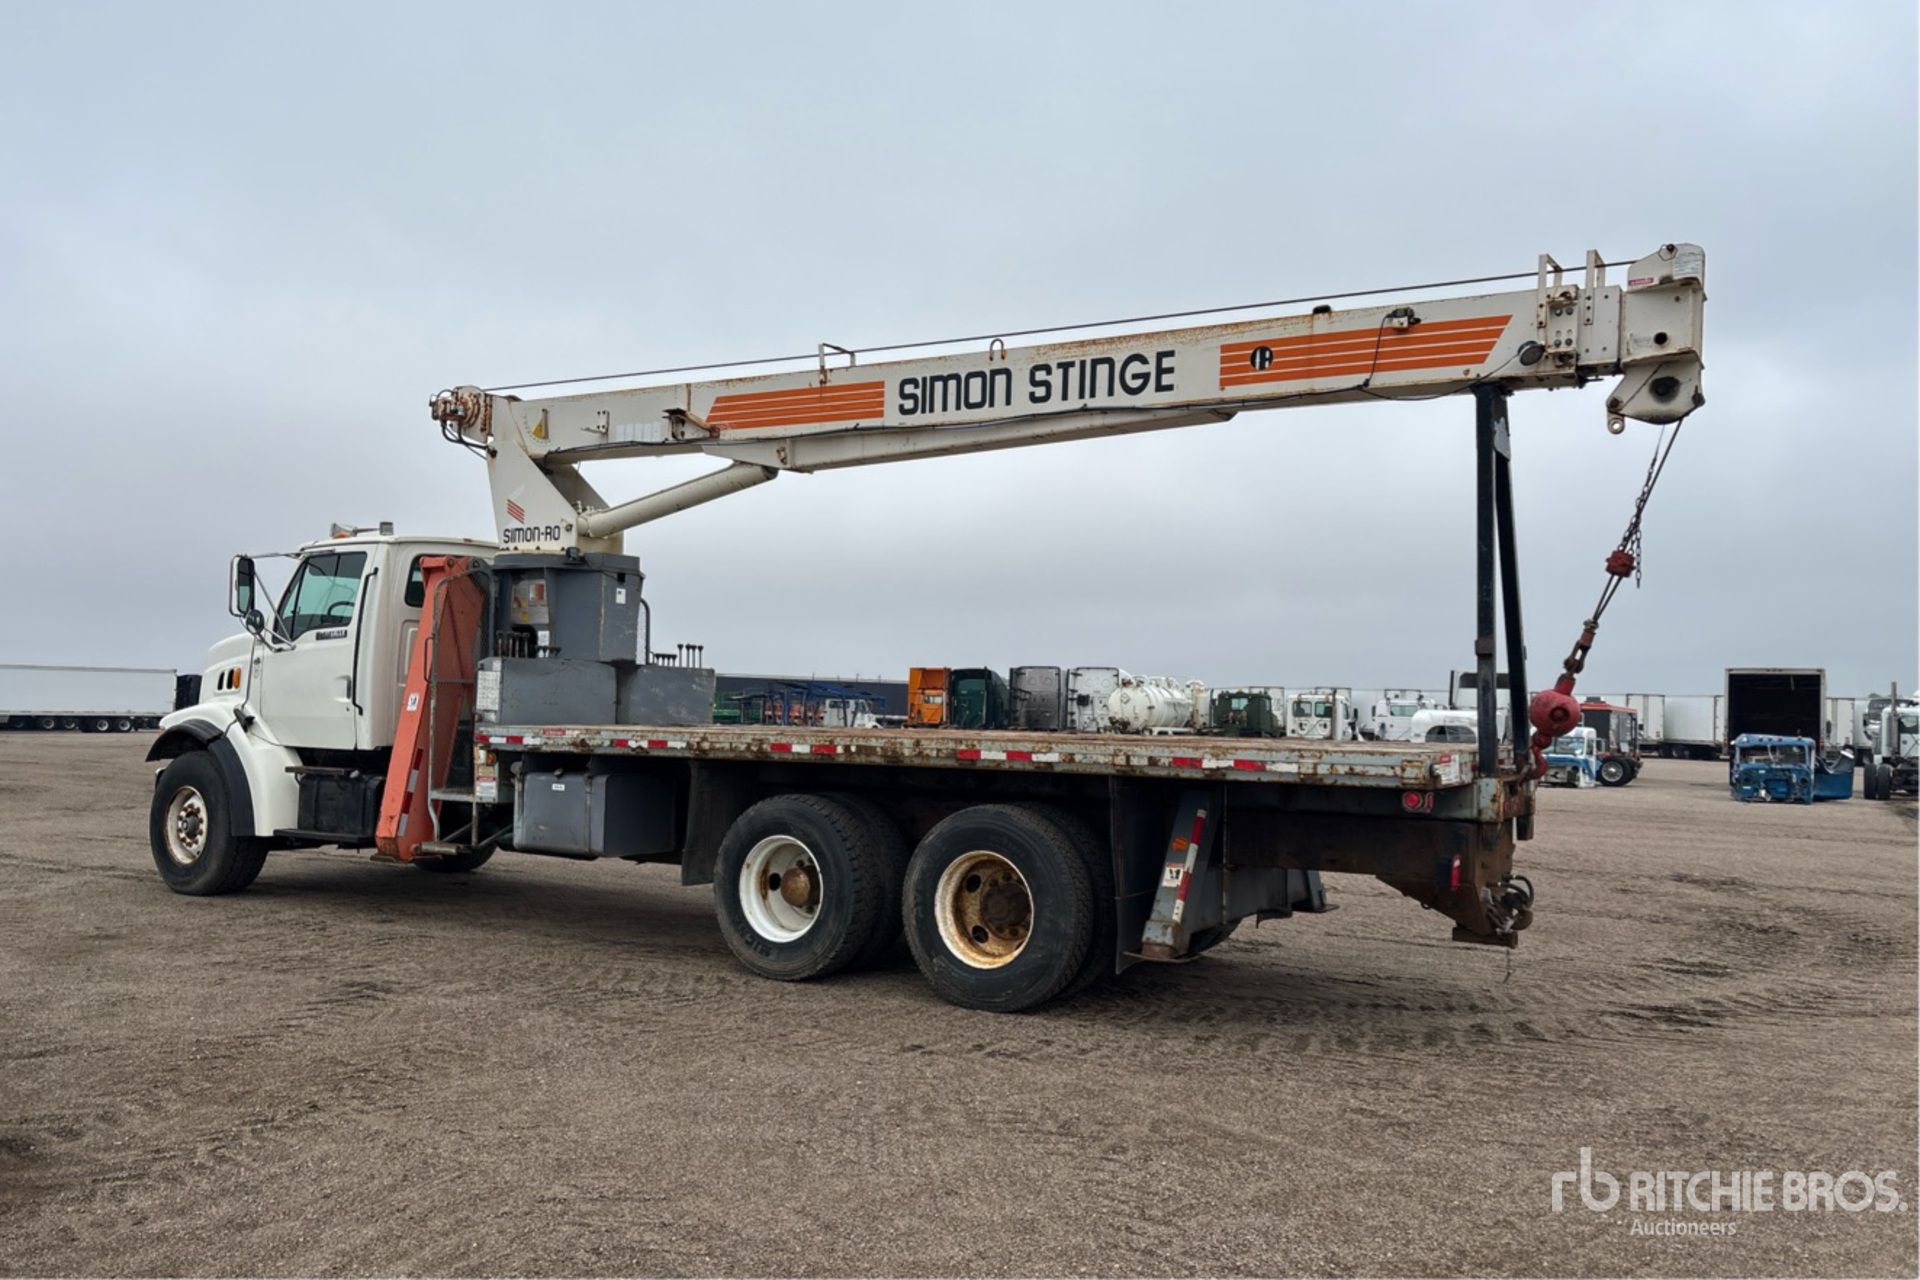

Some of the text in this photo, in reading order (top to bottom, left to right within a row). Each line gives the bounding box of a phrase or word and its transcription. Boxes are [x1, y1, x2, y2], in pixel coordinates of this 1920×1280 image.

[898, 350, 1176, 415] SIMON STINGE
[503, 525, 561, 544] SIMON-RO
